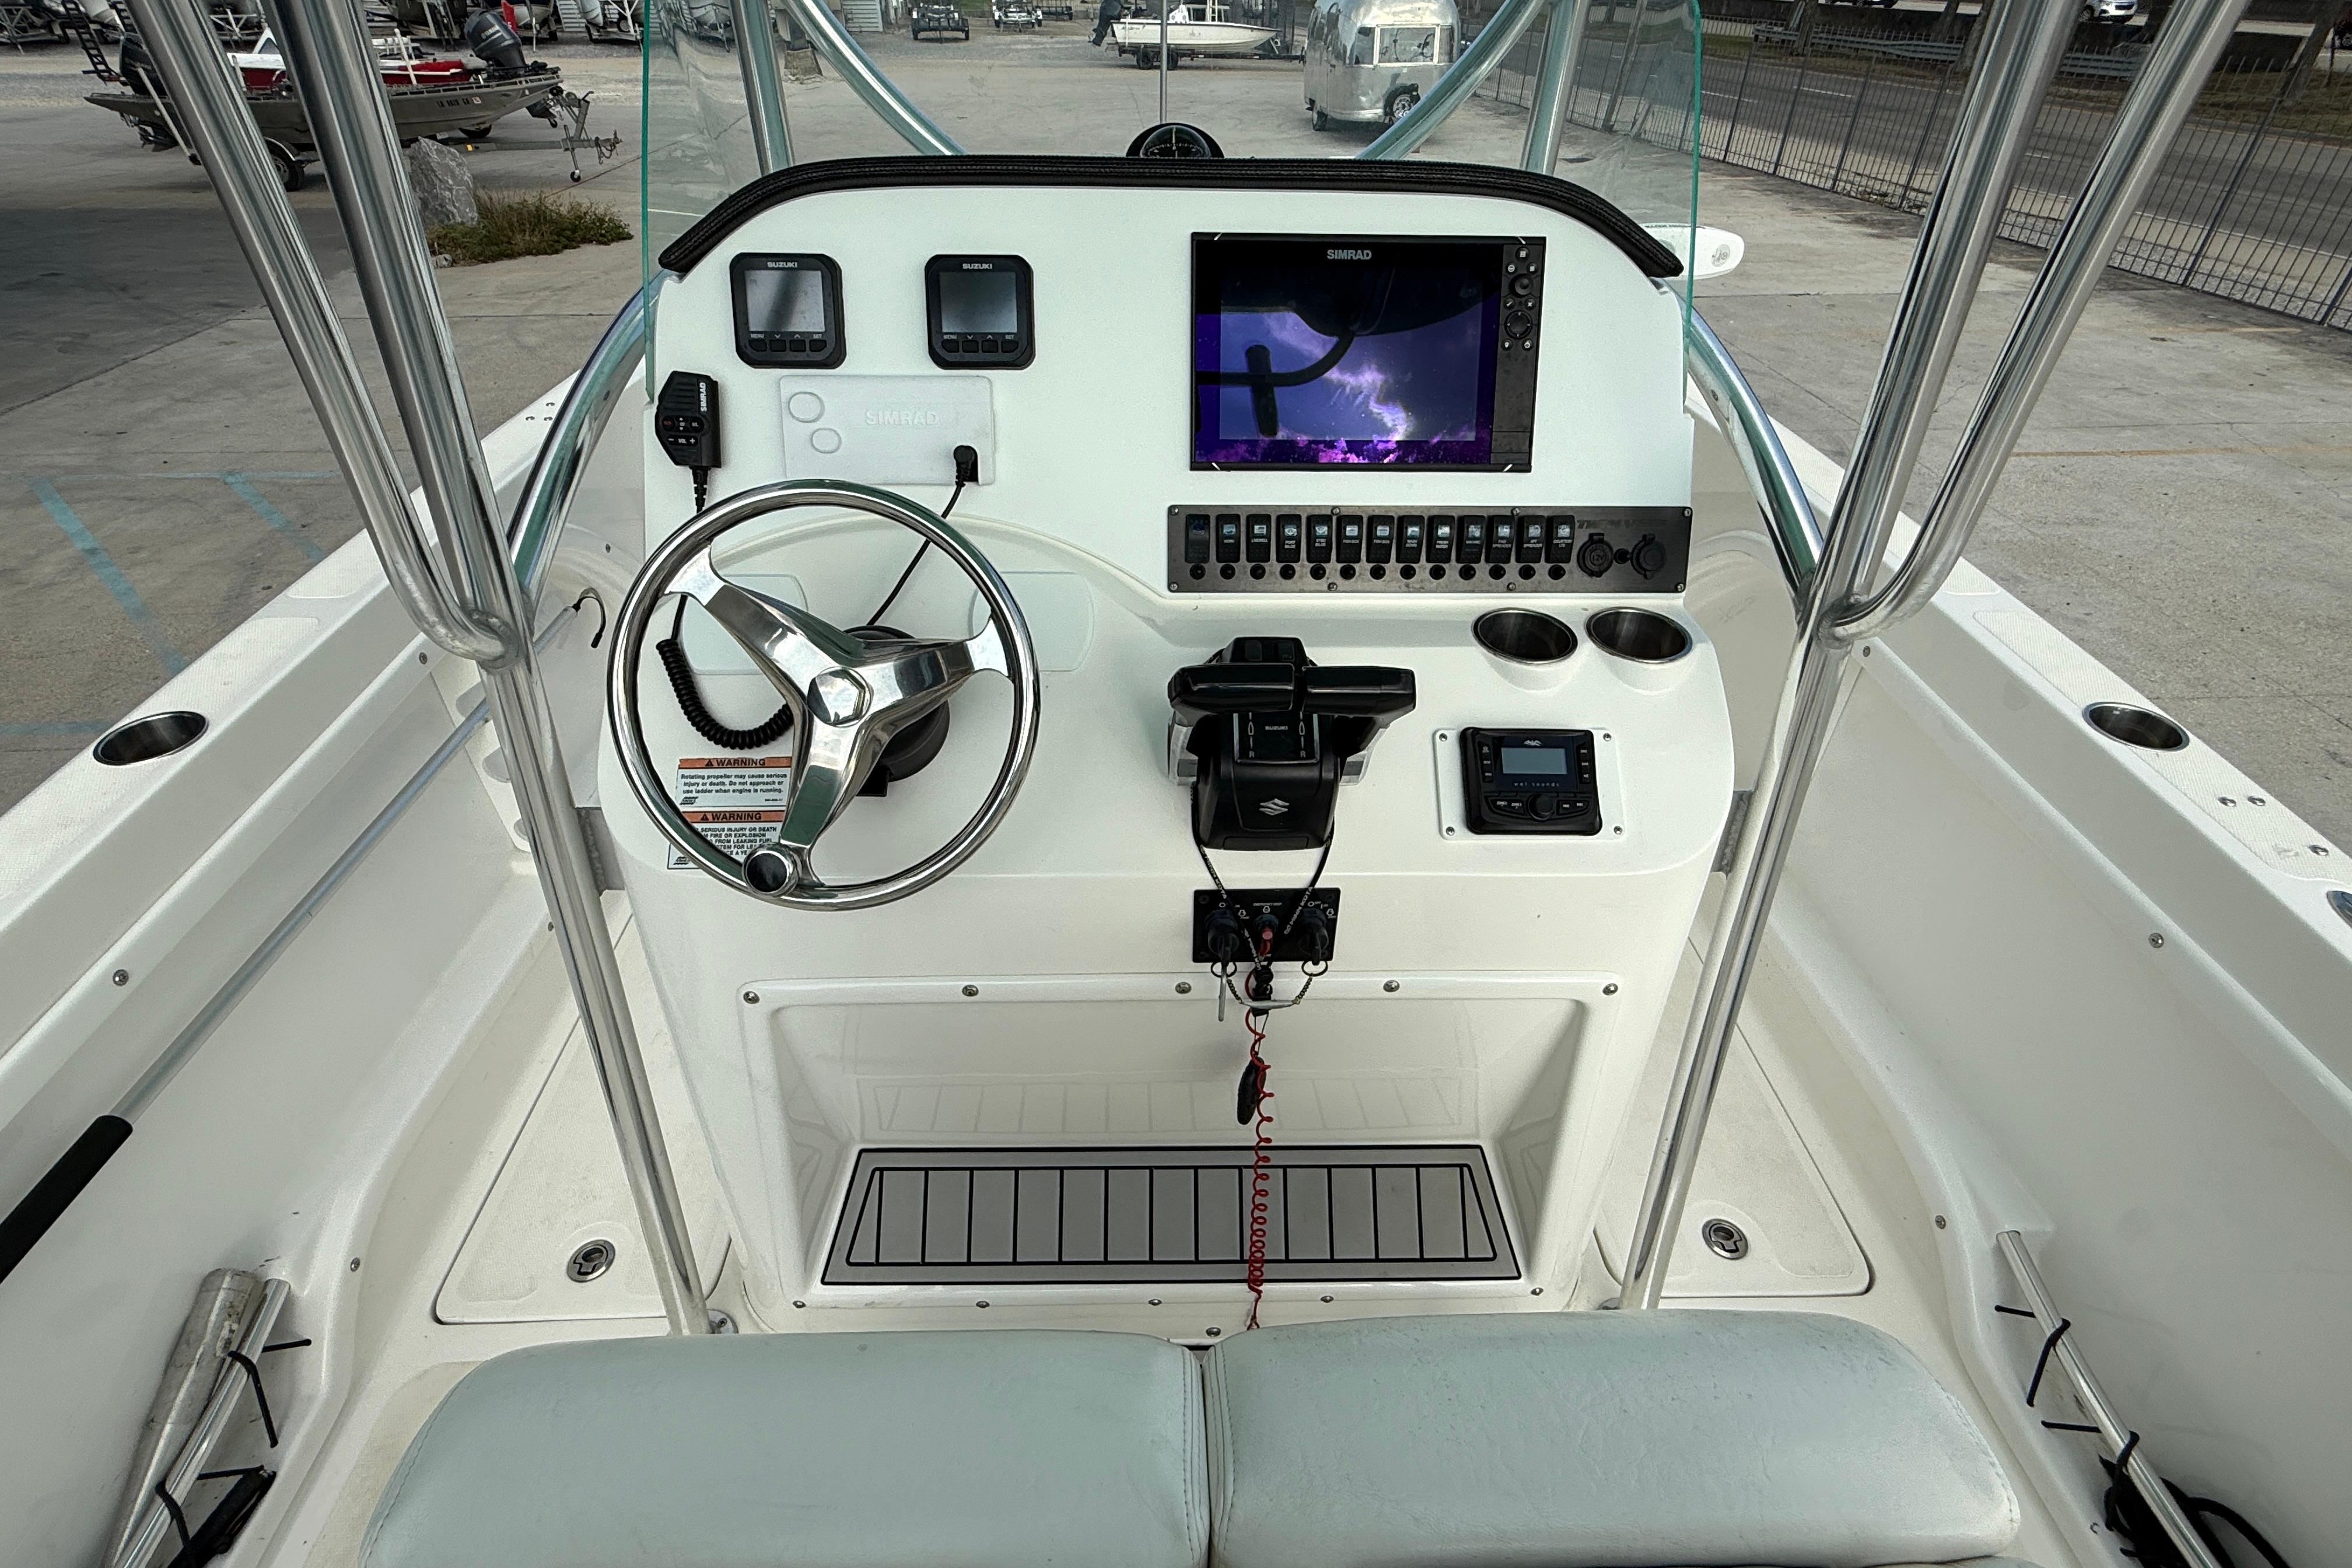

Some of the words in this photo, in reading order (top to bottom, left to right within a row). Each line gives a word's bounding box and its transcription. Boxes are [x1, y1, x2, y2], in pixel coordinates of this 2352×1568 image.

[1327, 249, 1372, 260] SIMRAD
[865, 410, 939, 426] SIMRAD
[1300, 887, 1313, 906] KOTA
